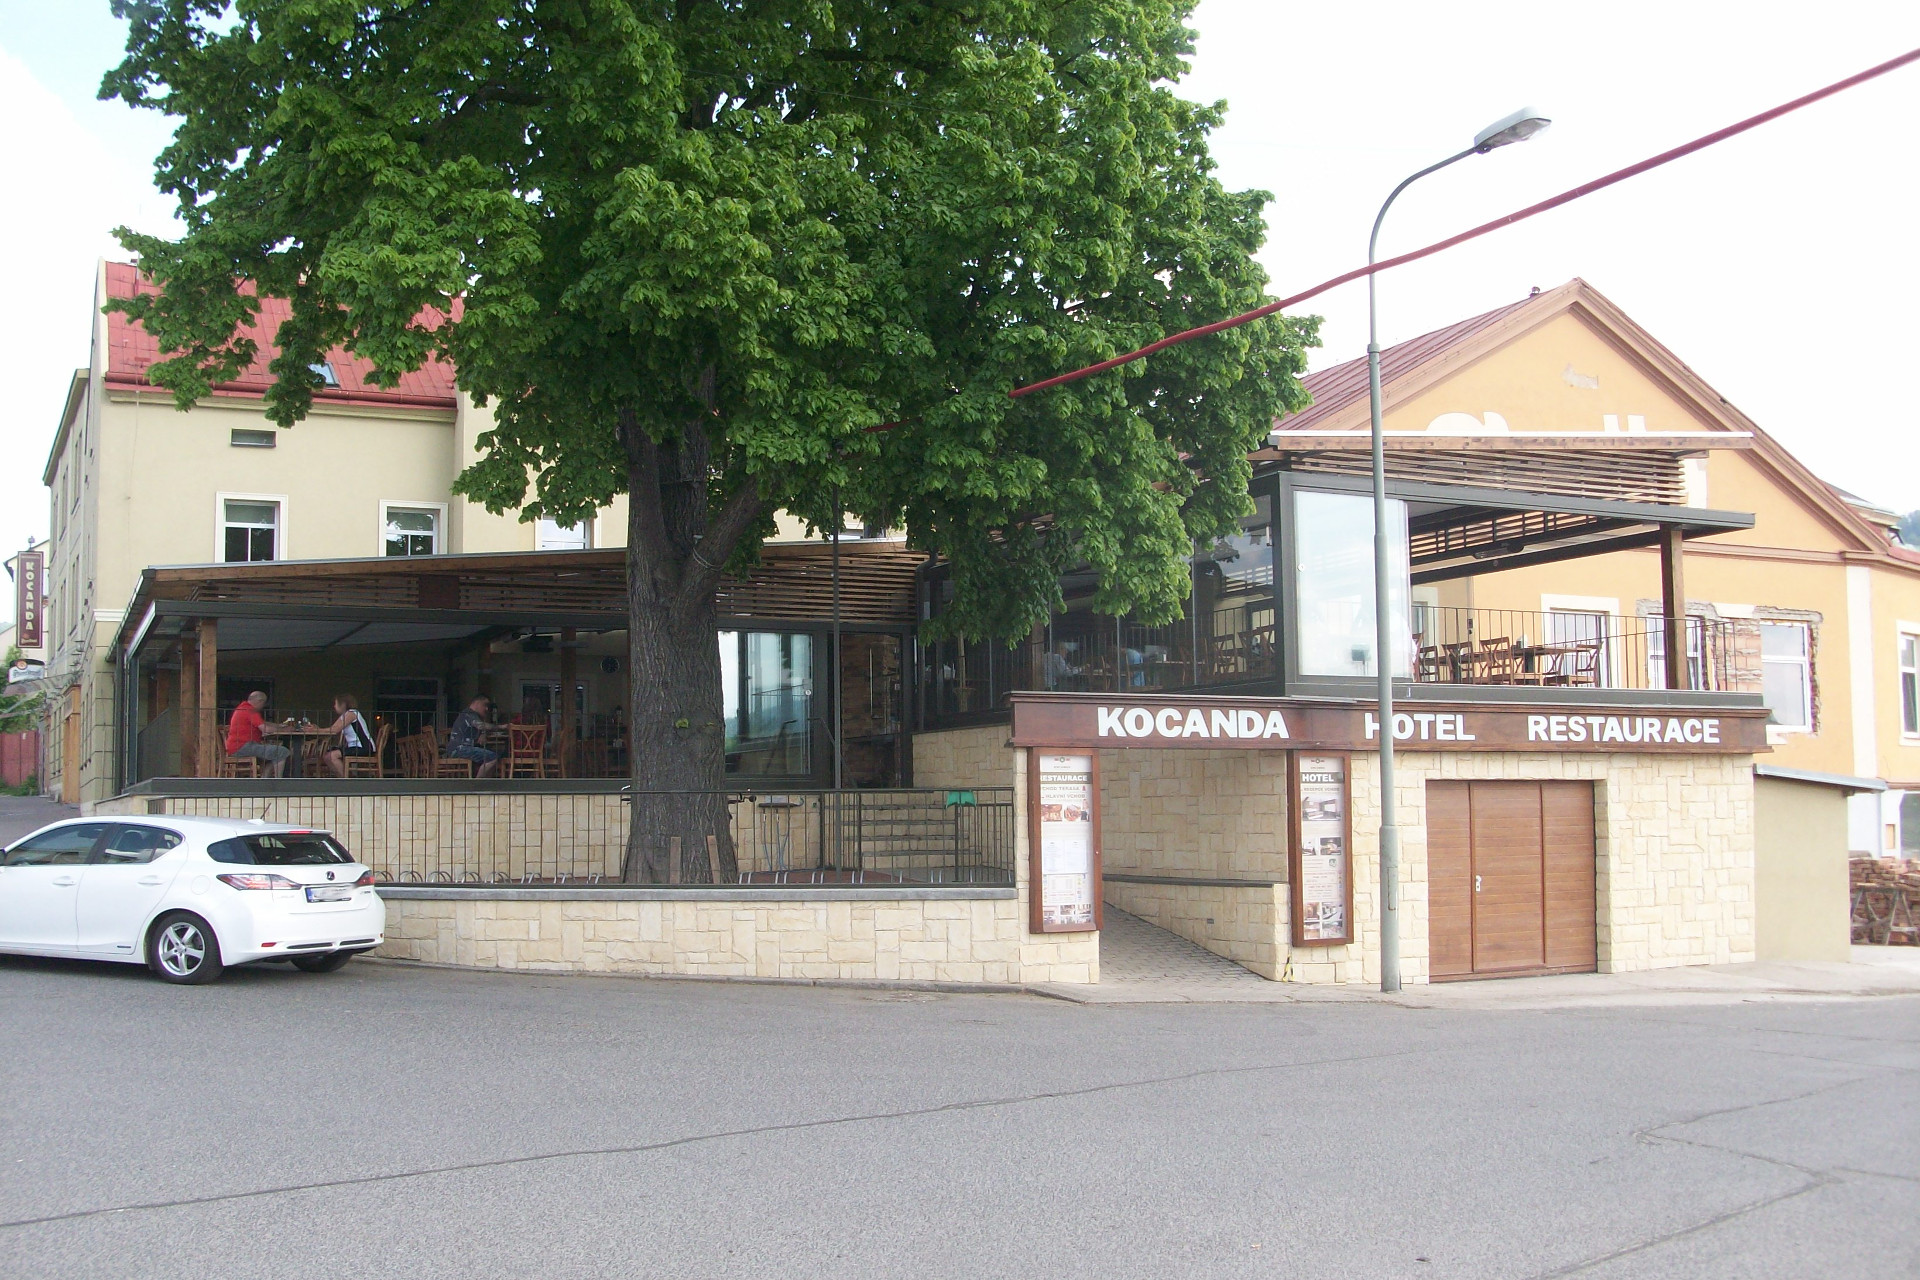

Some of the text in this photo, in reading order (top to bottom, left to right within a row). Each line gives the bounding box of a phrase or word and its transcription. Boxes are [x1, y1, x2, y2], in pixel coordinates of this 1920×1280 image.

[25, 561, 35, 631] KOCANDA
[1097, 706, 1289, 739] KOCANDA
[1364, 712, 1476, 741] HOTEL
[1527, 715, 1721, 743] RESTAURACE
[1302, 773, 1334, 782] HOTEL
